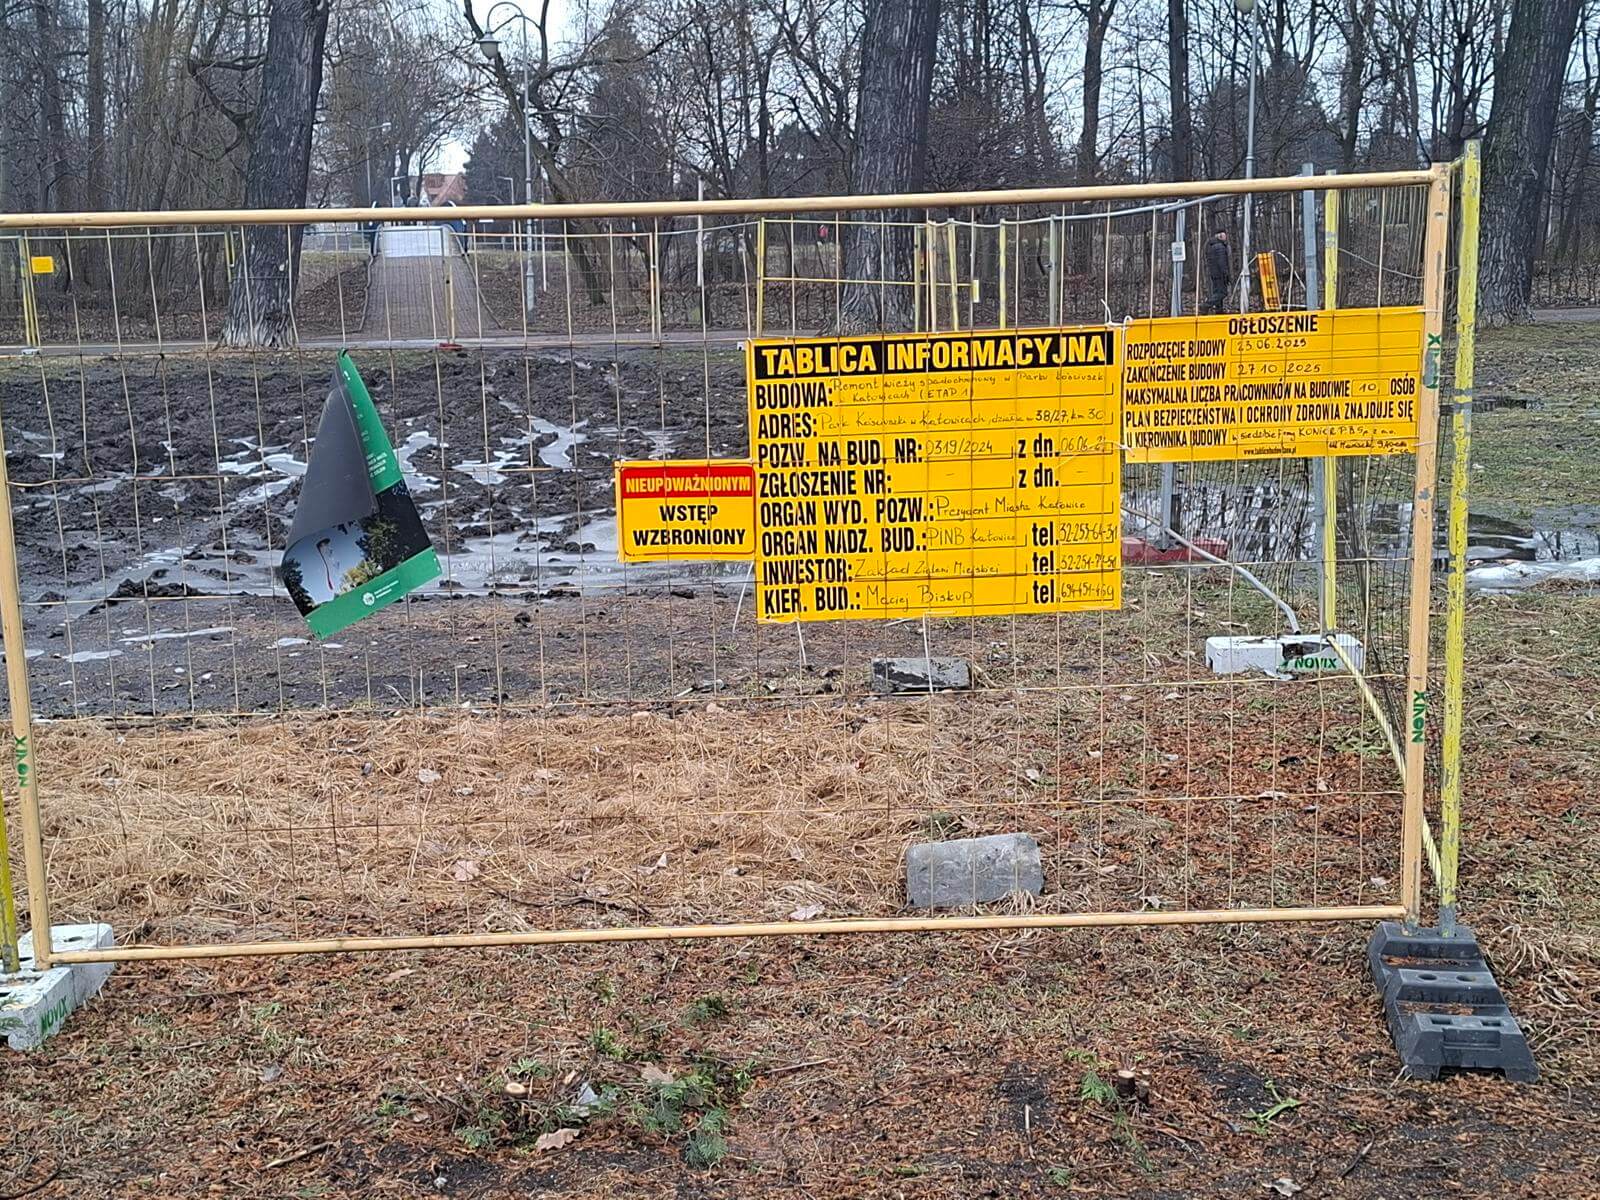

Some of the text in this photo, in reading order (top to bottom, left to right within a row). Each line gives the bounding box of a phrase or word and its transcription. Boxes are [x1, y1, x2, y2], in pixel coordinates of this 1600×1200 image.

[1229, 314, 1318, 335] OGŁOSZENIE
[762, 335, 1106, 376] TABLICA INFORMACYJNA
[1127, 339, 1226, 362] ROZPOCZĘCIE BUDOWY
[830, 378, 880, 391] Remont
[1127, 362, 1227, 383] ZAKOŃCZENIE BUDOWY
[1390, 373, 1415, 395] OSÓB
[756, 382, 833, 410] BUDOWA:
[1126, 378, 1351, 405] MAKSYMALNA LICZBA PRACOWNIKÓW NA BUDOWIE
[758, 412, 818, 439] ADRES:
[1126, 400, 1413, 428] PLAN BEZPIECZEŃSTWA I OCHRONY ZDROWIA ZNAJDUJE SIĘ
[1018, 432, 1060, 459] z dn.
[1126, 429, 1227, 448] U KIEROWNIKA BUDOWY
[758, 438, 923, 468] POZW. NA BUD. NR:
[625, 473, 751, 493] NIEUPOWAŻNIONYM
[759, 469, 892, 498] ZGŁOSZENIE NR:
[1018, 462, 1060, 489] z dn.
[659, 504, 718, 525] WSTĘP
[760, 497, 934, 528] ORGAN WYD. POZW.:
[633, 529, 746, 546] WZBRONIONY
[761, 527, 928, 557] ORGAN NADZ. BUD.:
[1032, 521, 1059, 547] tel.
[763, 558, 853, 586] INWESTOR:
[1032, 550, 1060, 576] tel.
[764, 586, 861, 615] KIER. BUD.:
[866, 584, 973, 612] Maciej Biskup
[1294, 656, 1338, 669] NOVIX
[1412, 690, 1426, 743] NOVIX
[14, 736, 29, 787] NOVIX
[41, 995, 67, 1033] NOVIX
